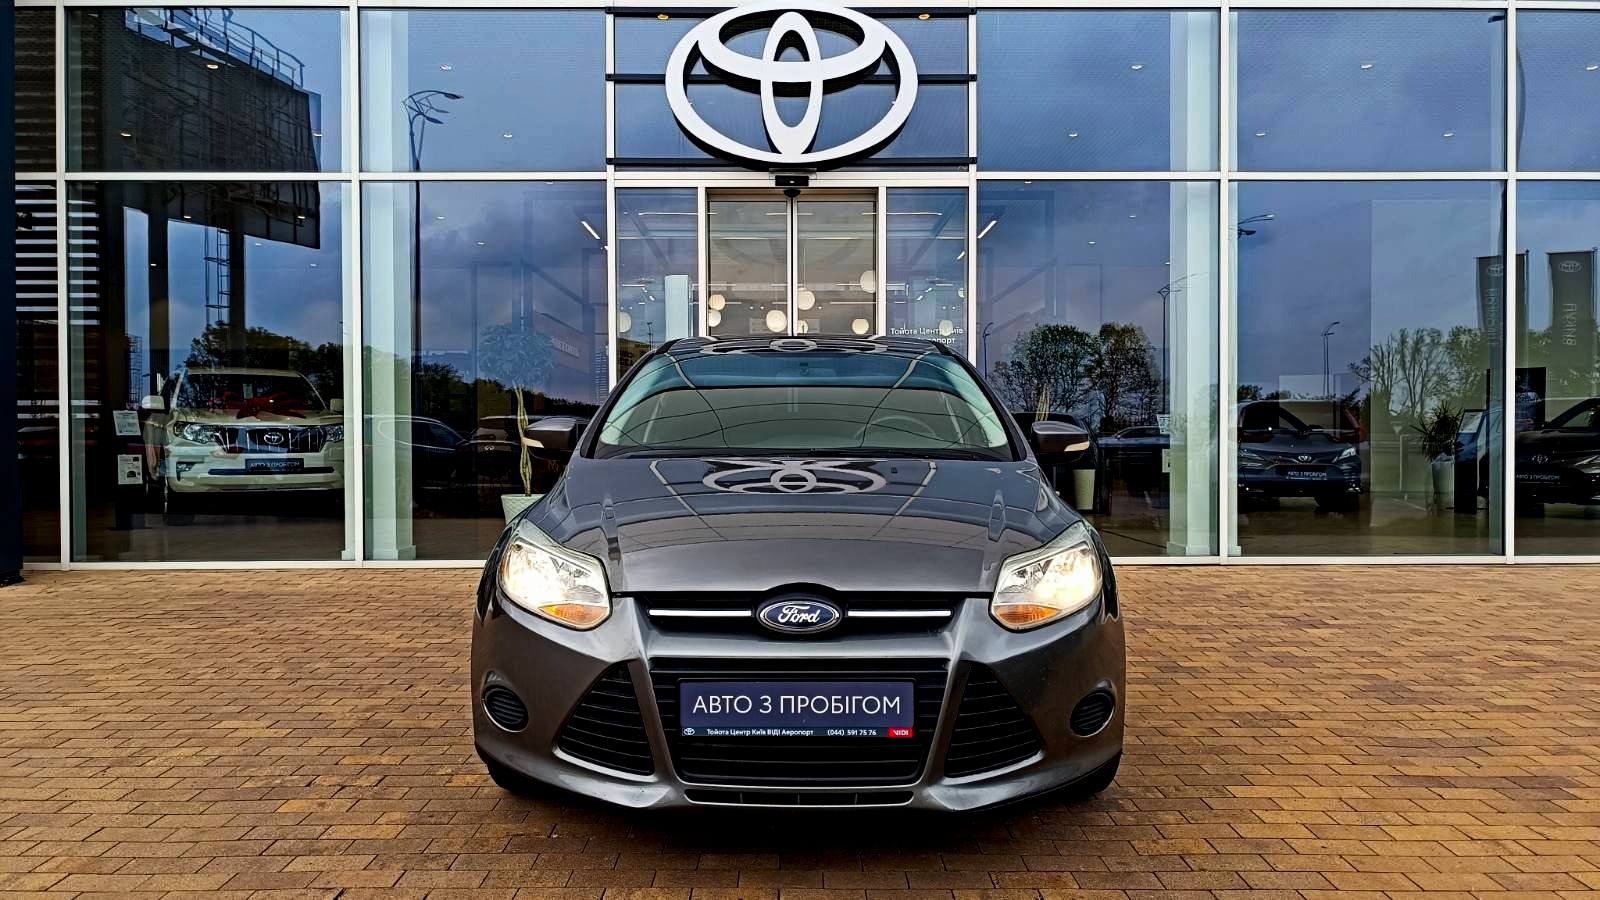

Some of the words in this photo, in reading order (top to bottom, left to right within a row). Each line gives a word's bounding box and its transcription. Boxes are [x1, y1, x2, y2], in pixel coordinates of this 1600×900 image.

[890, 327, 918, 335] Тойота
[777, 605, 821, 623] Ford
[692, 695, 753, 714] АВТО
[759, 695, 772, 714] З
[779, 695, 901, 714] ПРОБІГОМ
[730, 728, 751, 736] Центр
[781, 728, 814, 736] Аеропорт
[827, 728, 845, 737] (044)
